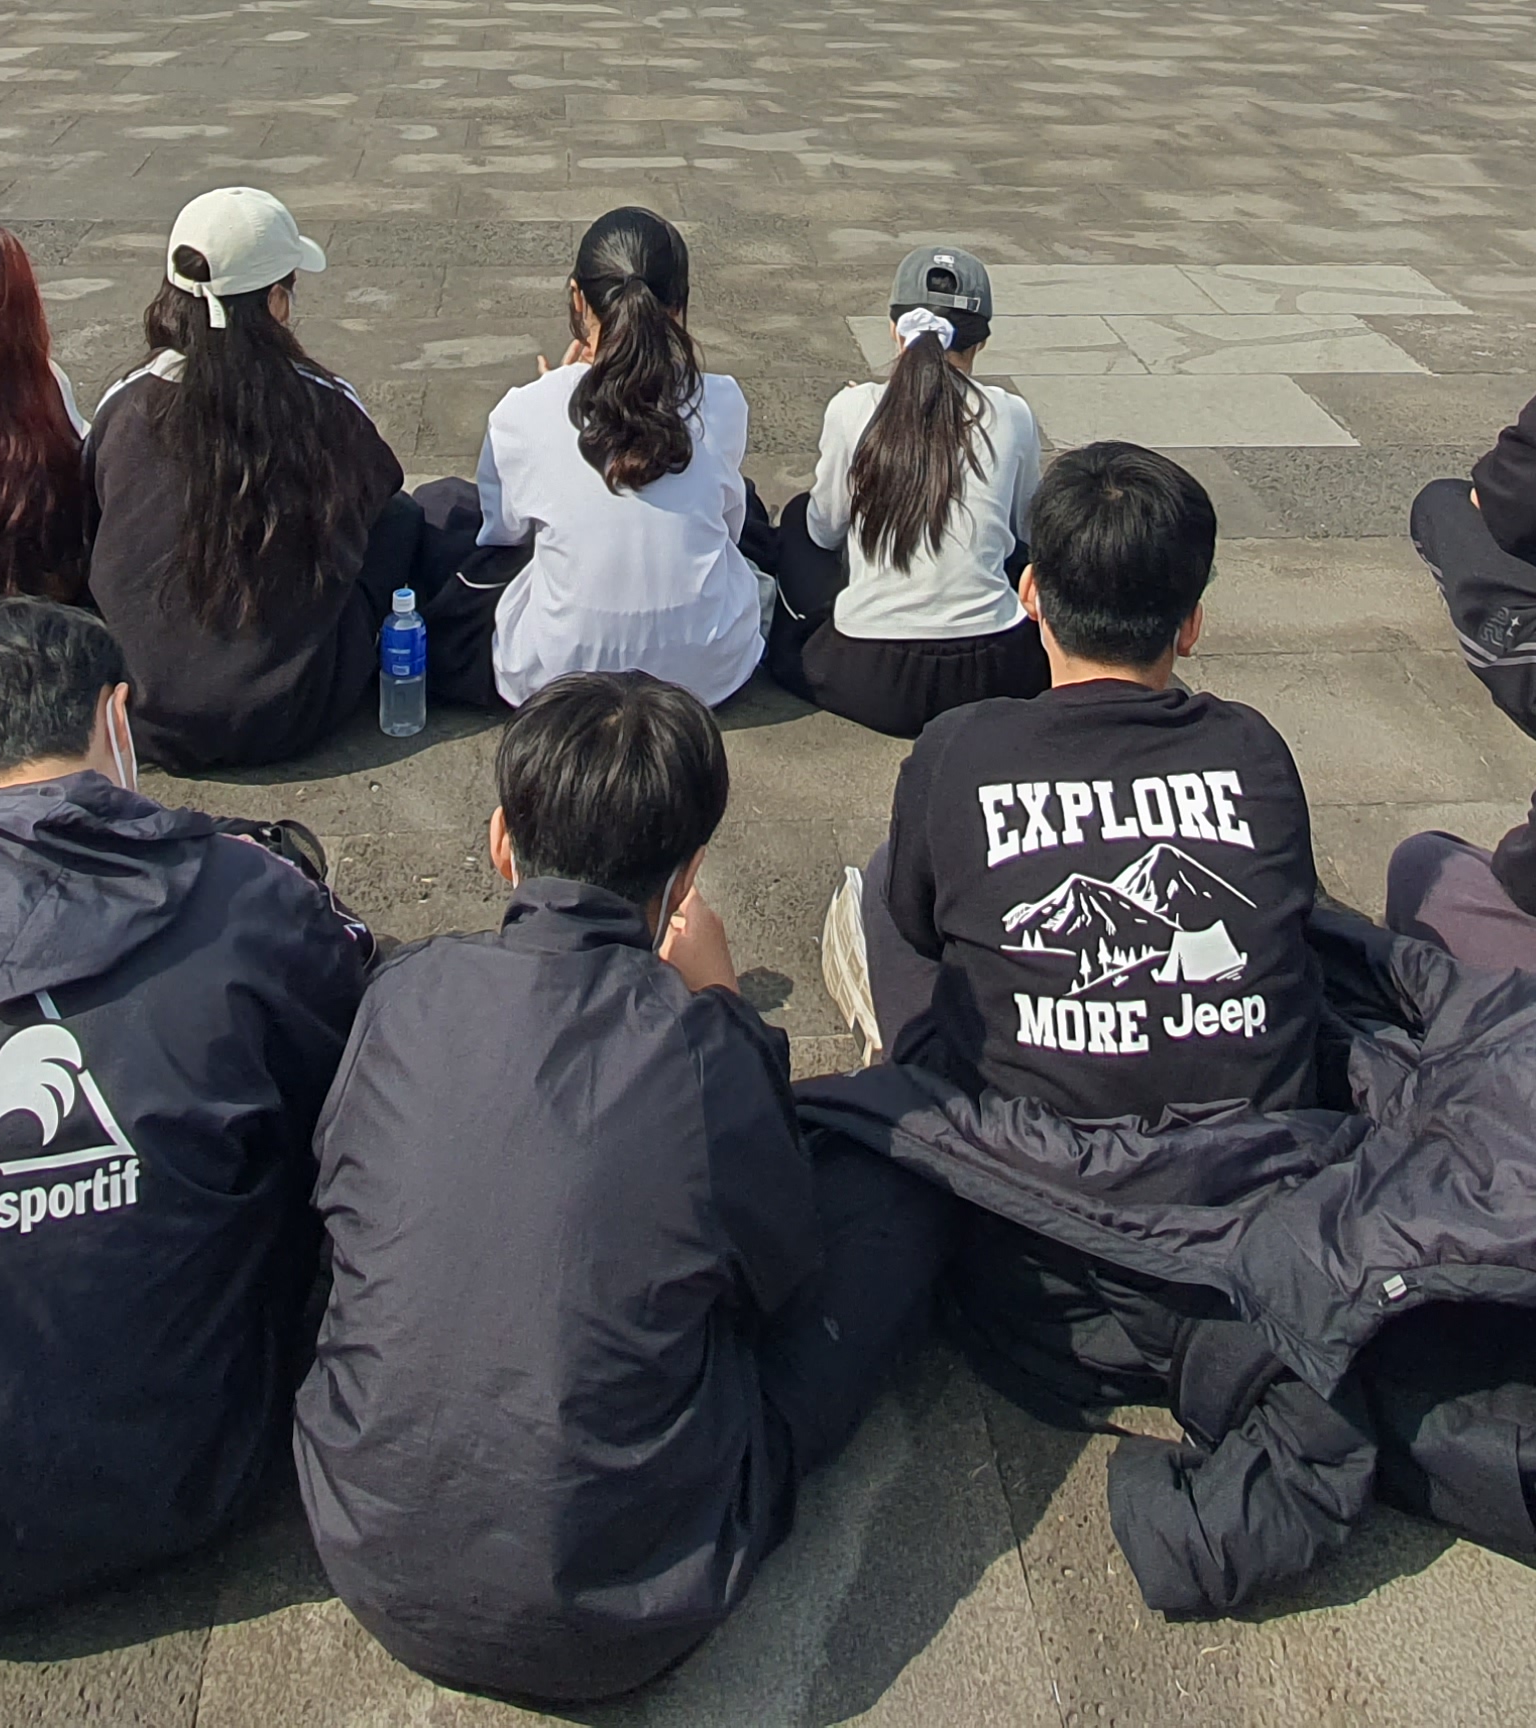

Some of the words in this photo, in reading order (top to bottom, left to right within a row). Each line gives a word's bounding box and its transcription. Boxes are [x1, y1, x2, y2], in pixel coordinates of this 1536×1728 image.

[978, 770, 1255, 867] EXPLORE
[1014, 993, 1149, 1054] MORE
[1163, 993, 1266, 1038] Jeep
